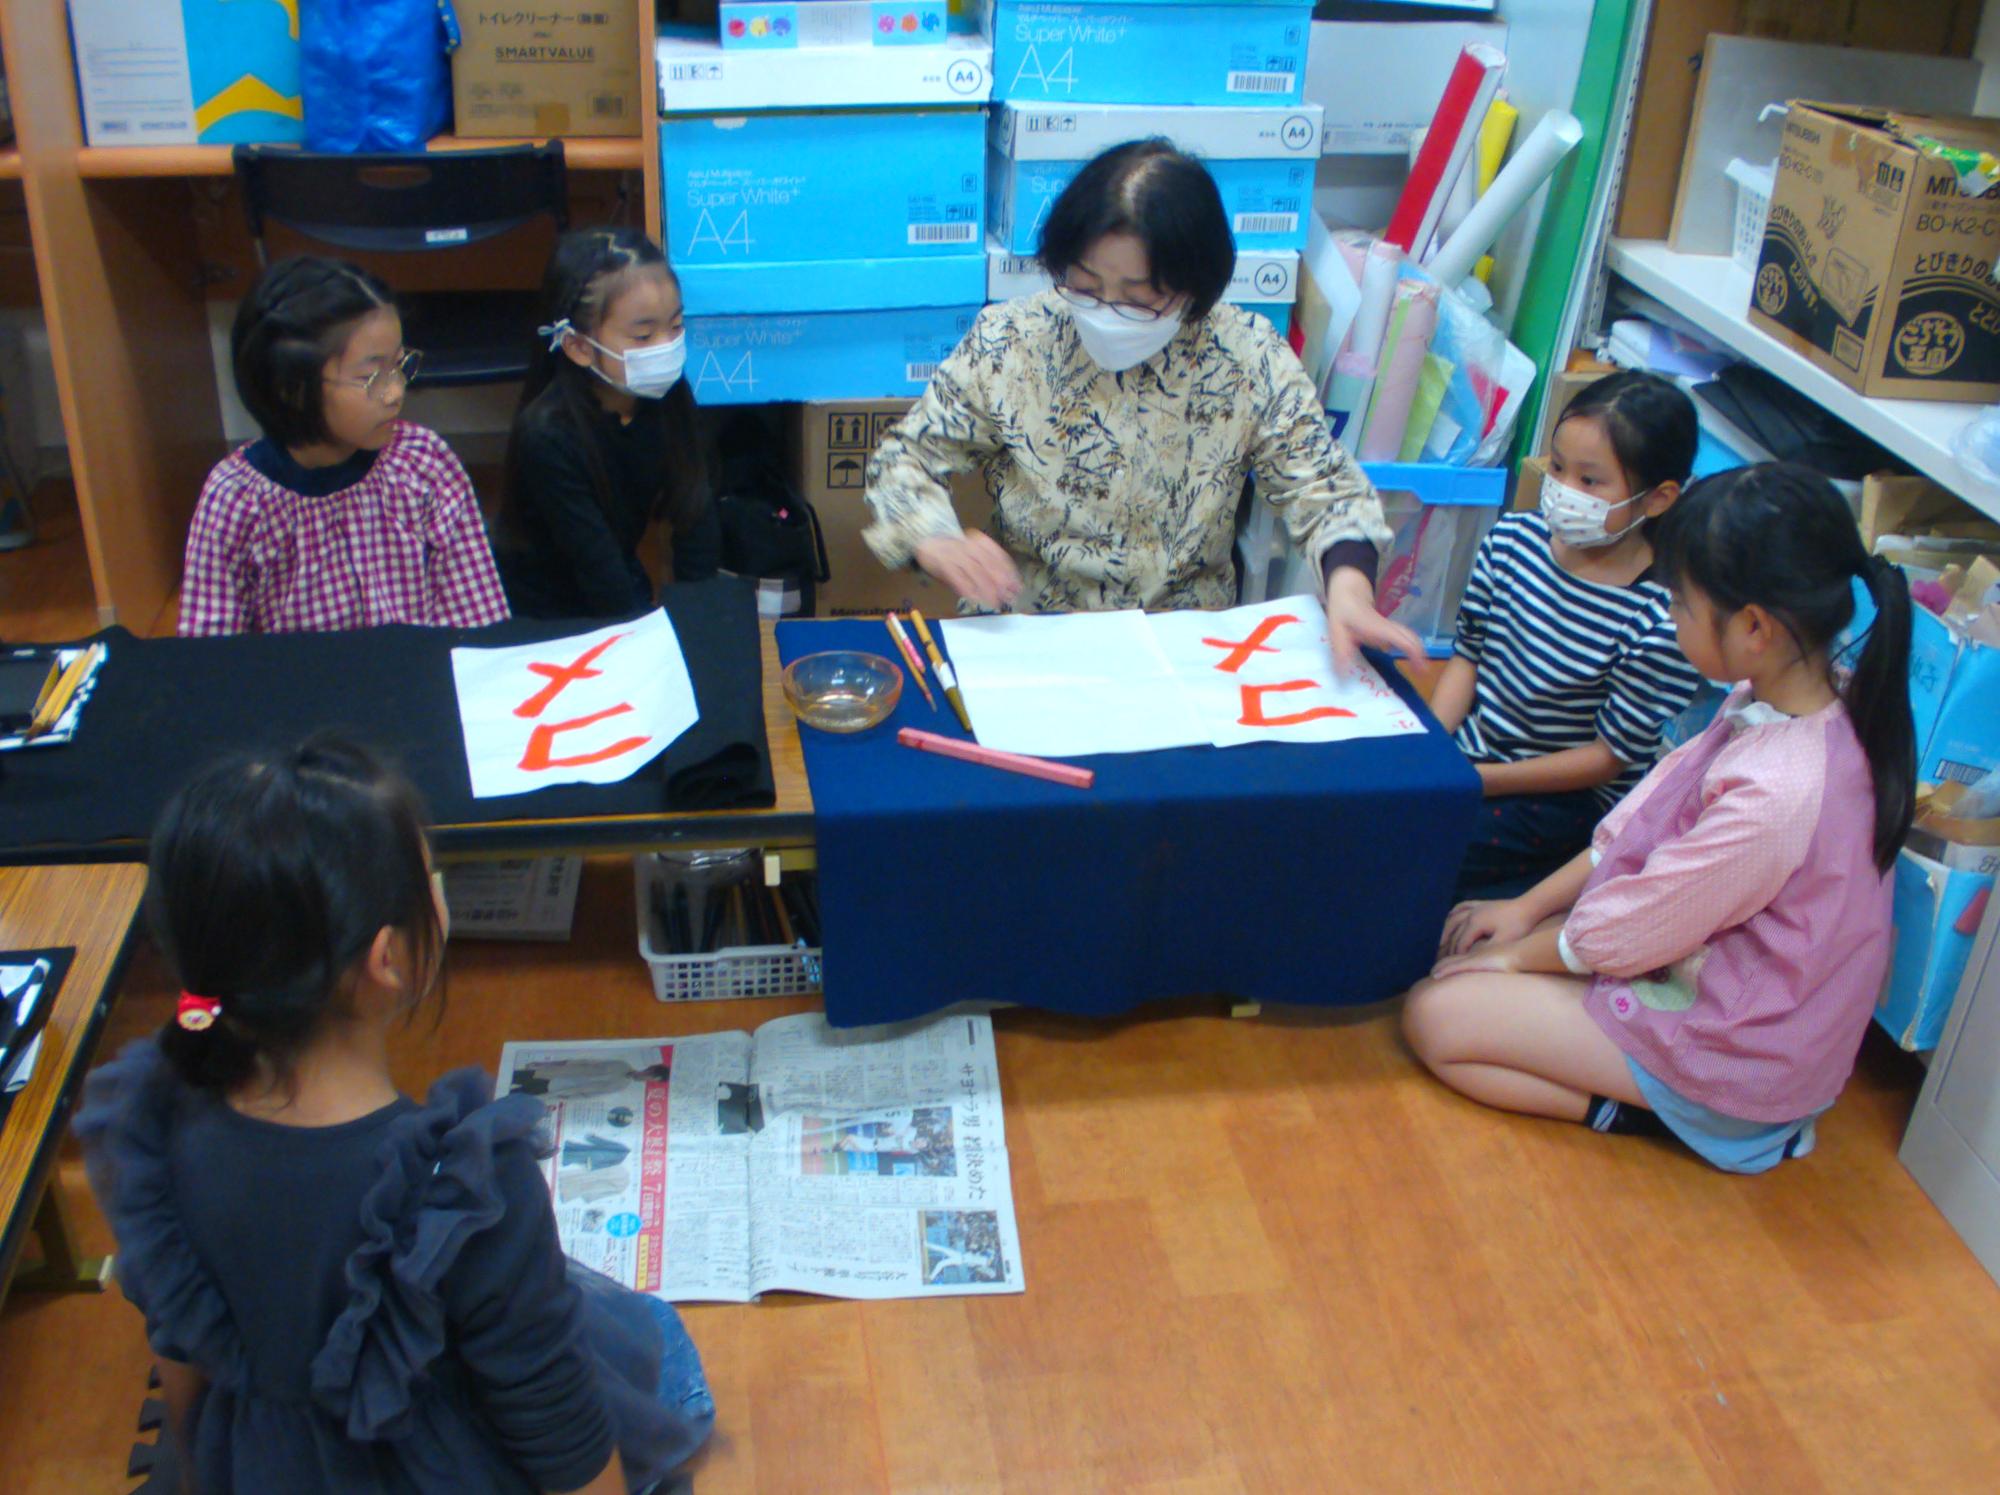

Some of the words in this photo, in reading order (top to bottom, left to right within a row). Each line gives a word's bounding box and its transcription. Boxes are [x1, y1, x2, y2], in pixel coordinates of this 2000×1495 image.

[1015, 24, 1065, 45] Super
[496, 48, 596, 60] SMARTVALUE
[955, 71, 974, 83] A4
[1009, 43, 1079, 94] A4
[1288, 126, 1306, 139] A4
[687, 189, 738, 208] Super
[688, 208, 756, 256] A4
[1262, 273, 1280, 286] A4
[693, 330, 740, 348] Super
[693, 350, 760, 394] A4
